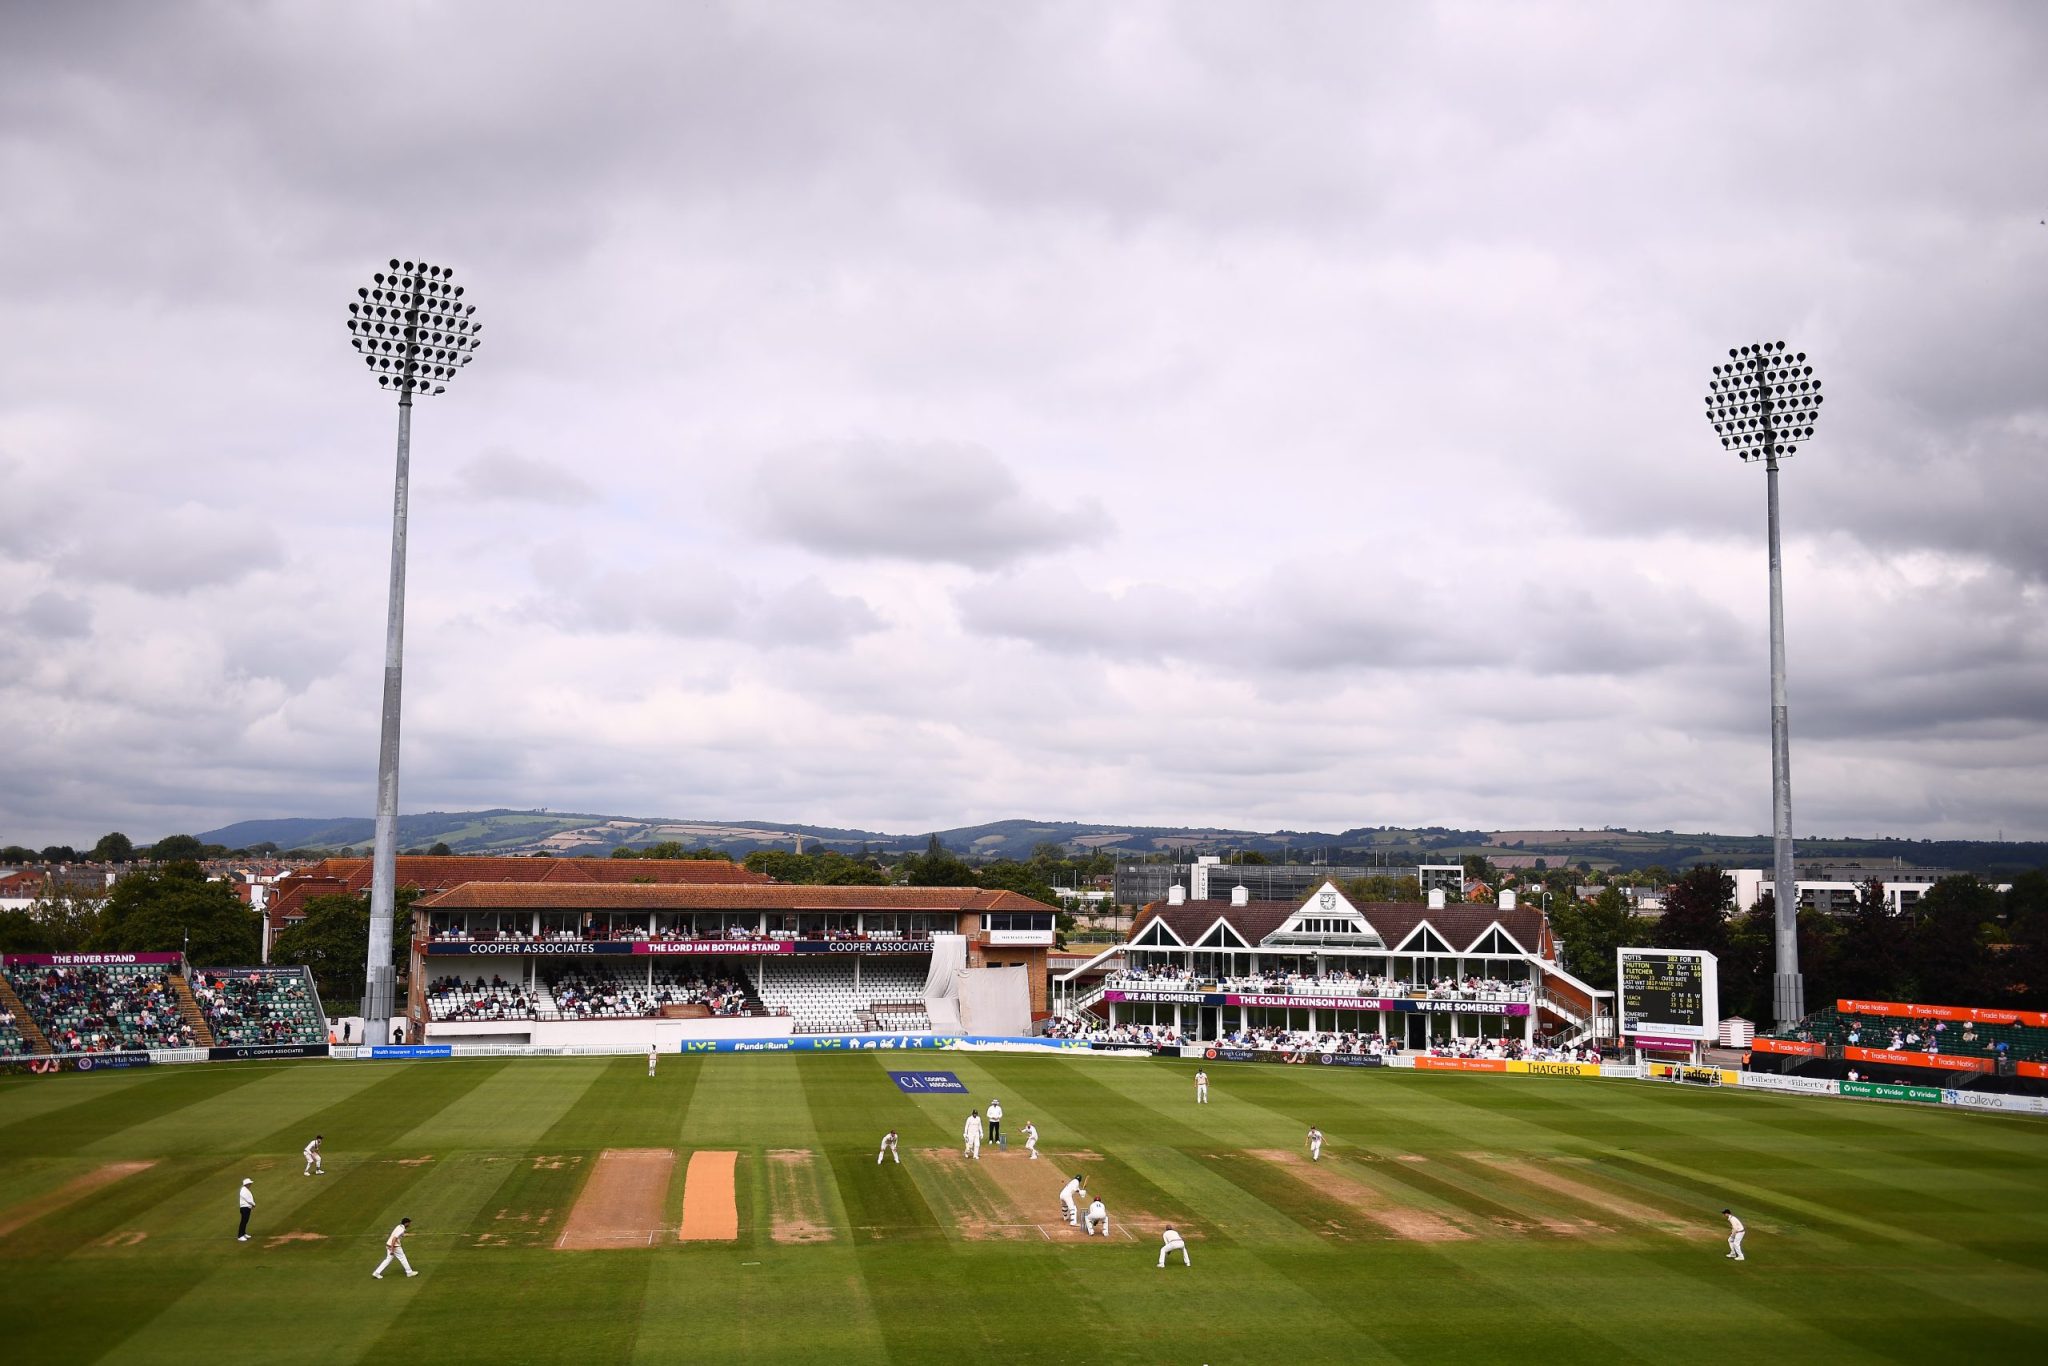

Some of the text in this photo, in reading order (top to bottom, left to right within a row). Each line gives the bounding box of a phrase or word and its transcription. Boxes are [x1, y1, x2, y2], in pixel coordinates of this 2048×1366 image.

[470, 944, 594, 953] COOPER ASSOCIATES
[830, 942, 934, 952] COOPER ASSOCIATES
[52, 954, 136, 964] THE RIVER STAND
[1124, 992, 1206, 1002] WE ARE SOMERSET
[1239, 996, 1380, 1008] THE COLIN ATKINSON PAVILION
[1416, 1002, 1506, 1013] WE ARE SOMERSET
[1527, 1062, 1581, 1075] THATCHERS
[900, 1076, 925, 1088] CA
[1964, 1094, 2002, 1106] calleva
